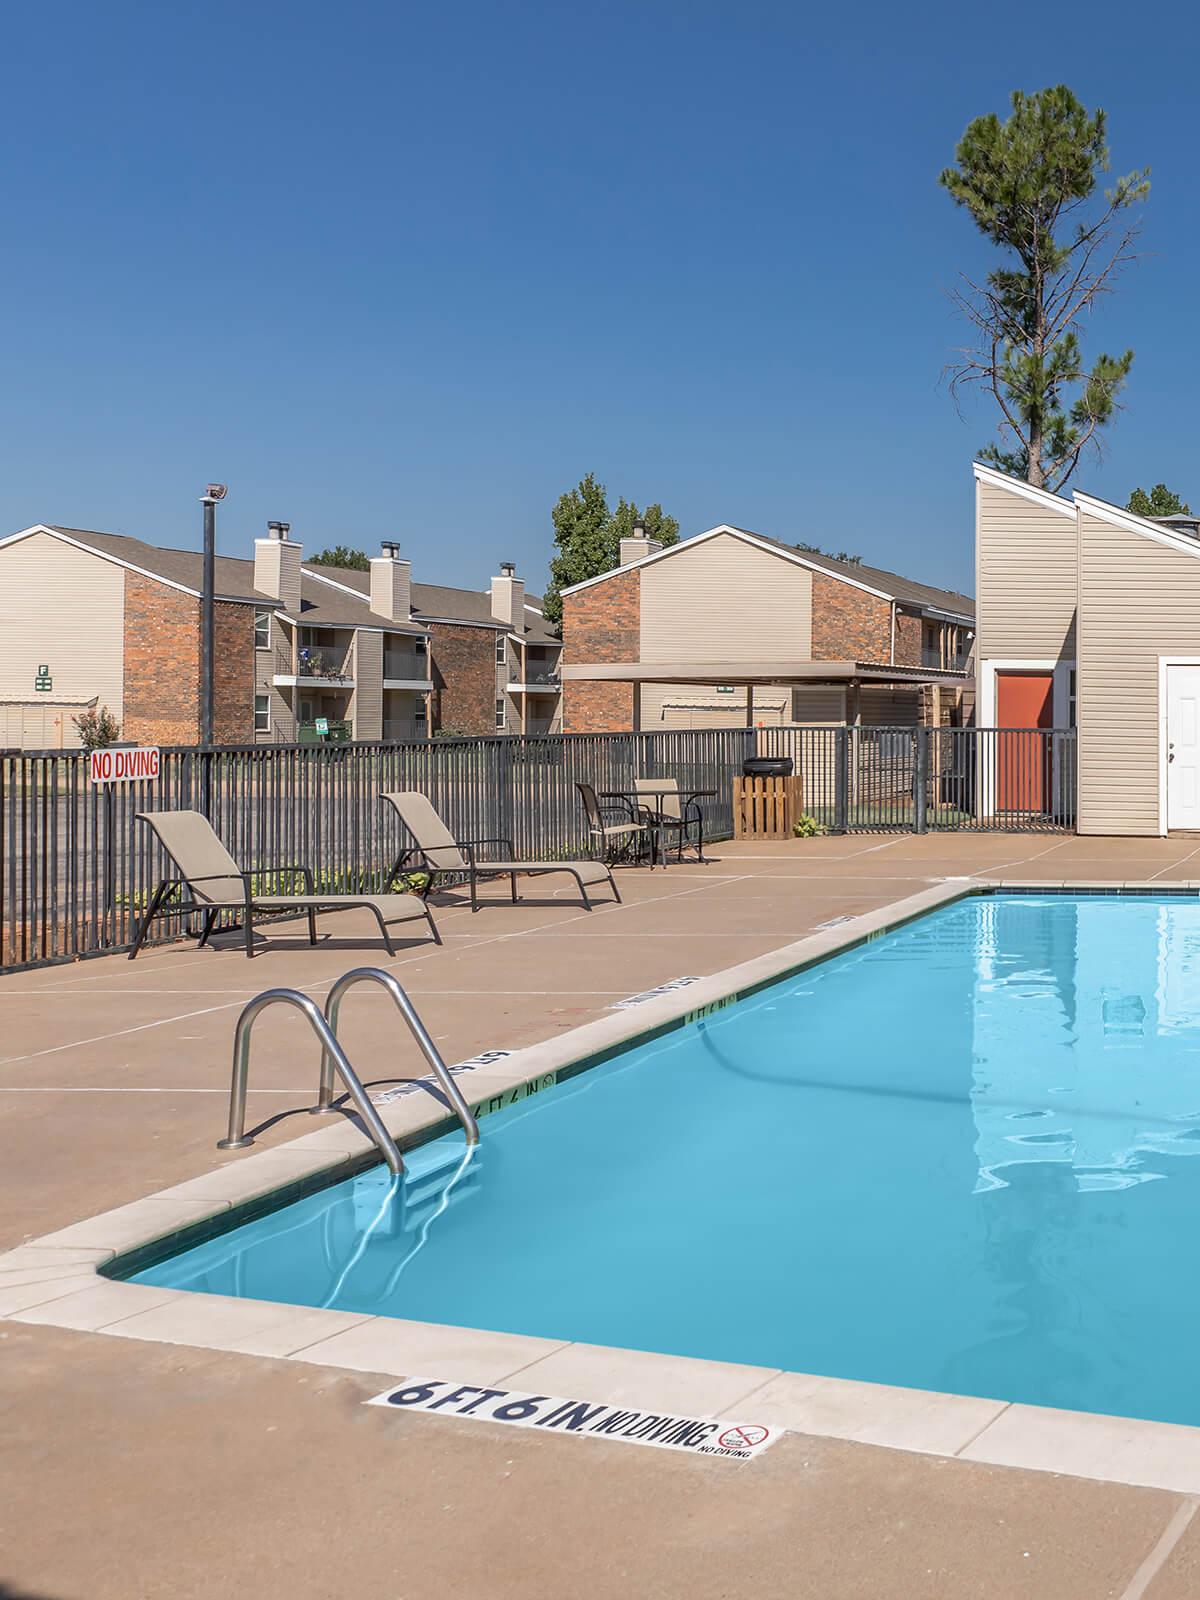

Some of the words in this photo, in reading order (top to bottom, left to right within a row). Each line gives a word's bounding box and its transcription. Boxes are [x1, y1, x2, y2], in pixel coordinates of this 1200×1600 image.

[93, 752, 111, 779] NO
[115, 751, 159, 777] DIVING
[490, 1094, 503, 1113] FT
[527, 1080, 538, 1096] IN
[387, 1381, 448, 1405] 6
[426, 1385, 510, 1415] FT.
[493, 1396, 552, 1420] 6
[534, 1400, 609, 1432] IN.
[589, 1410, 641, 1434] NO
[621, 1415, 719, 1447] DIVING
[698, 1446, 714, 1454] NO
[714, 1447, 752, 1459] DIVING
